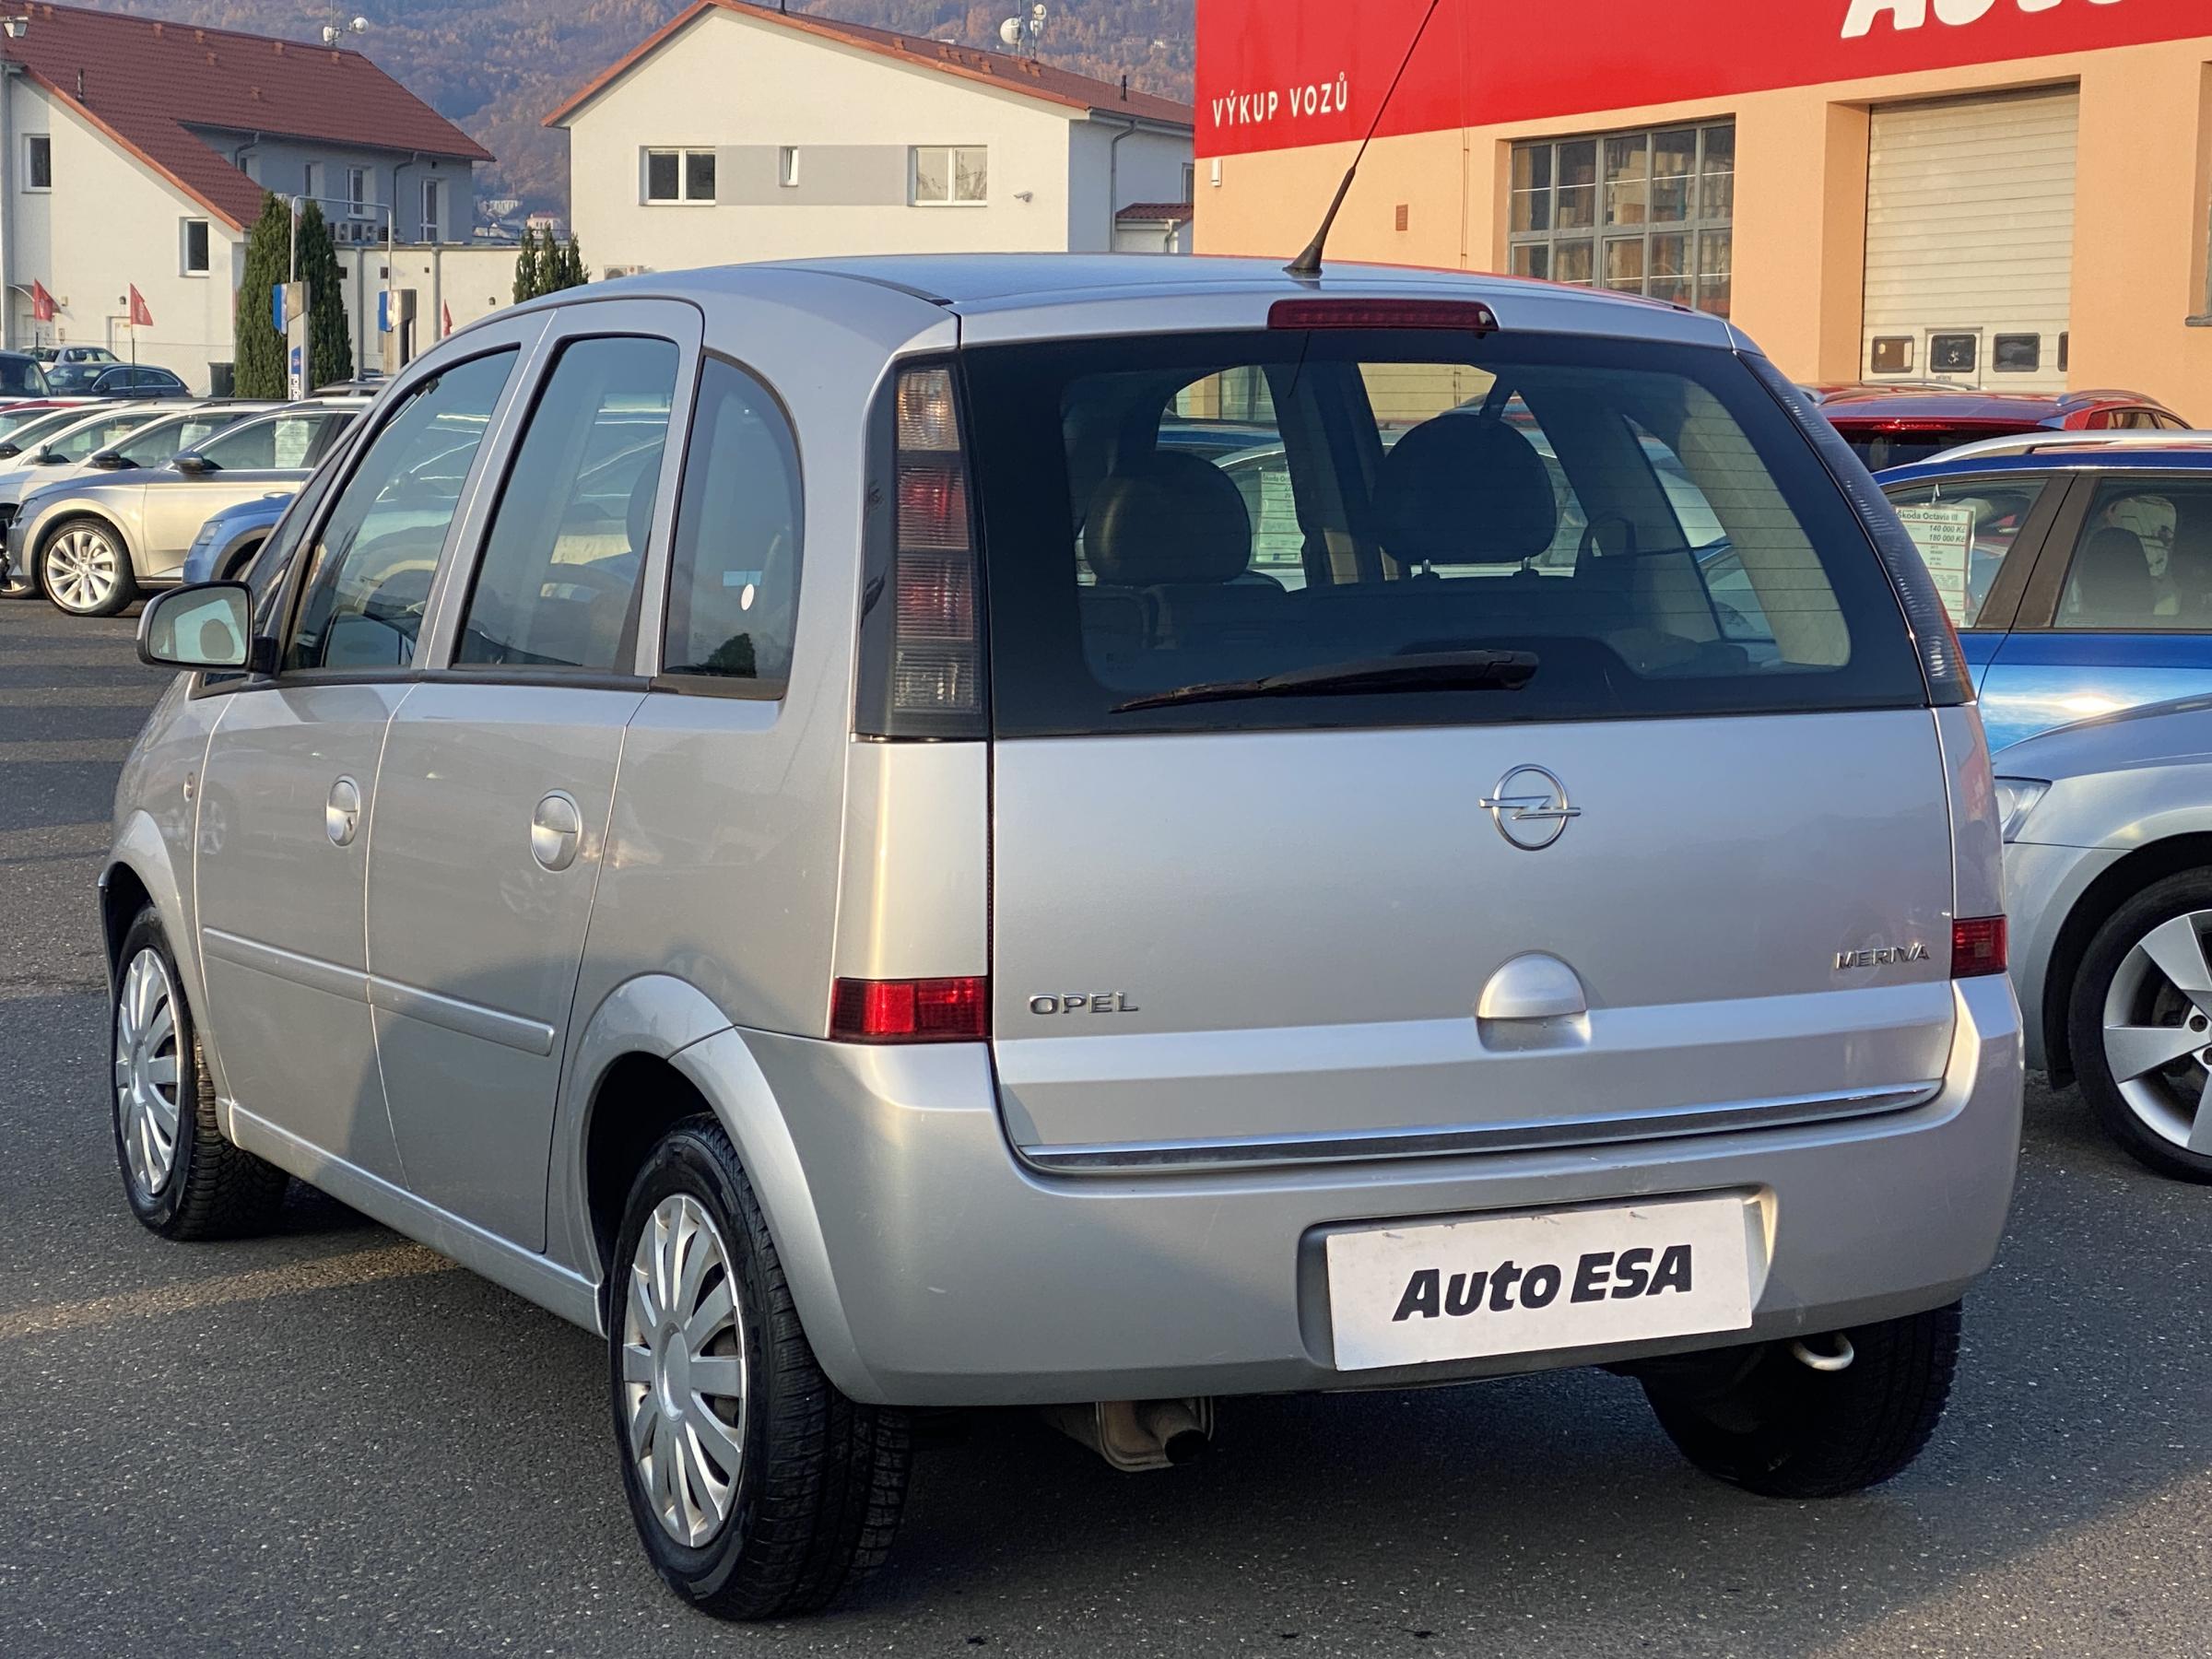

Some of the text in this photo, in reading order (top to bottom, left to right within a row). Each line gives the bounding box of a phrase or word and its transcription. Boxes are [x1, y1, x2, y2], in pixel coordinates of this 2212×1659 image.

[1212, 71, 1347, 128] VÝKUP VOZŮ
[1834, 942, 1930, 970] MERIVA
[1029, 991, 1140, 1015] OPEL
[1392, 1244, 1692, 1323] Auto ESA
